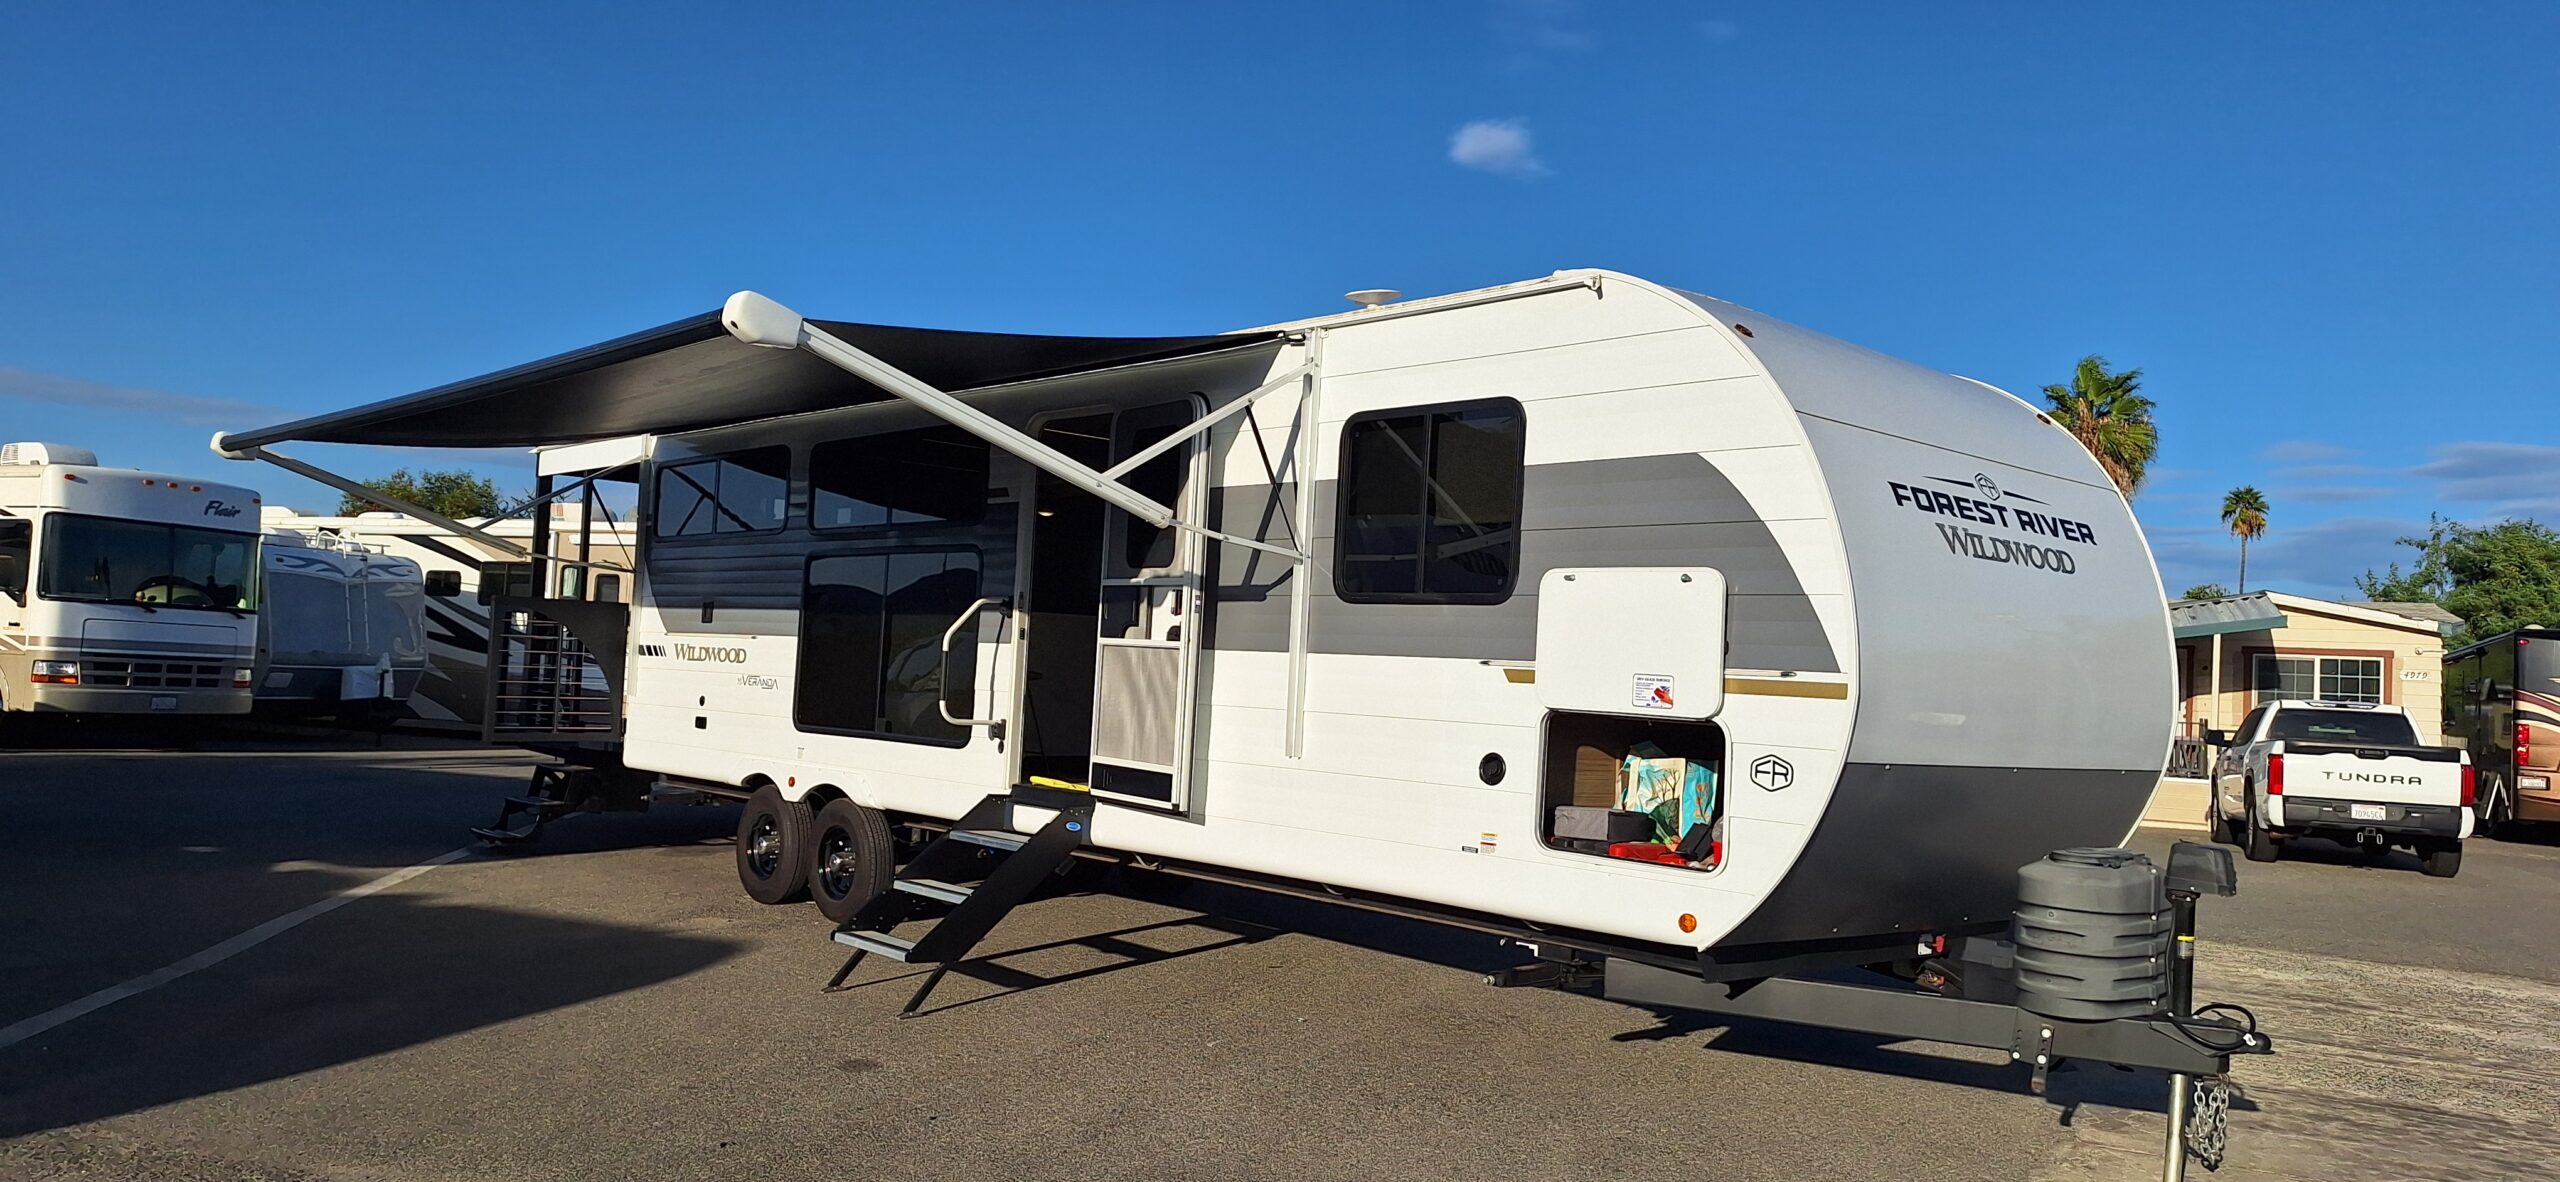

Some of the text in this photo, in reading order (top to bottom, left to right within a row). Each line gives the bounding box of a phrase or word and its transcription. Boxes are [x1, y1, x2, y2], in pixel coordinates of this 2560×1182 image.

[204, 500, 241, 518] Flair
[1887, 481, 2098, 546] FOREST RIVER
[1935, 522, 2076, 575] WILDWOOD
[674, 643, 747, 664] WILDWOOD
[741, 674, 779, 690] VERANDA
[2322, 771, 2422, 786] TUNDRA
